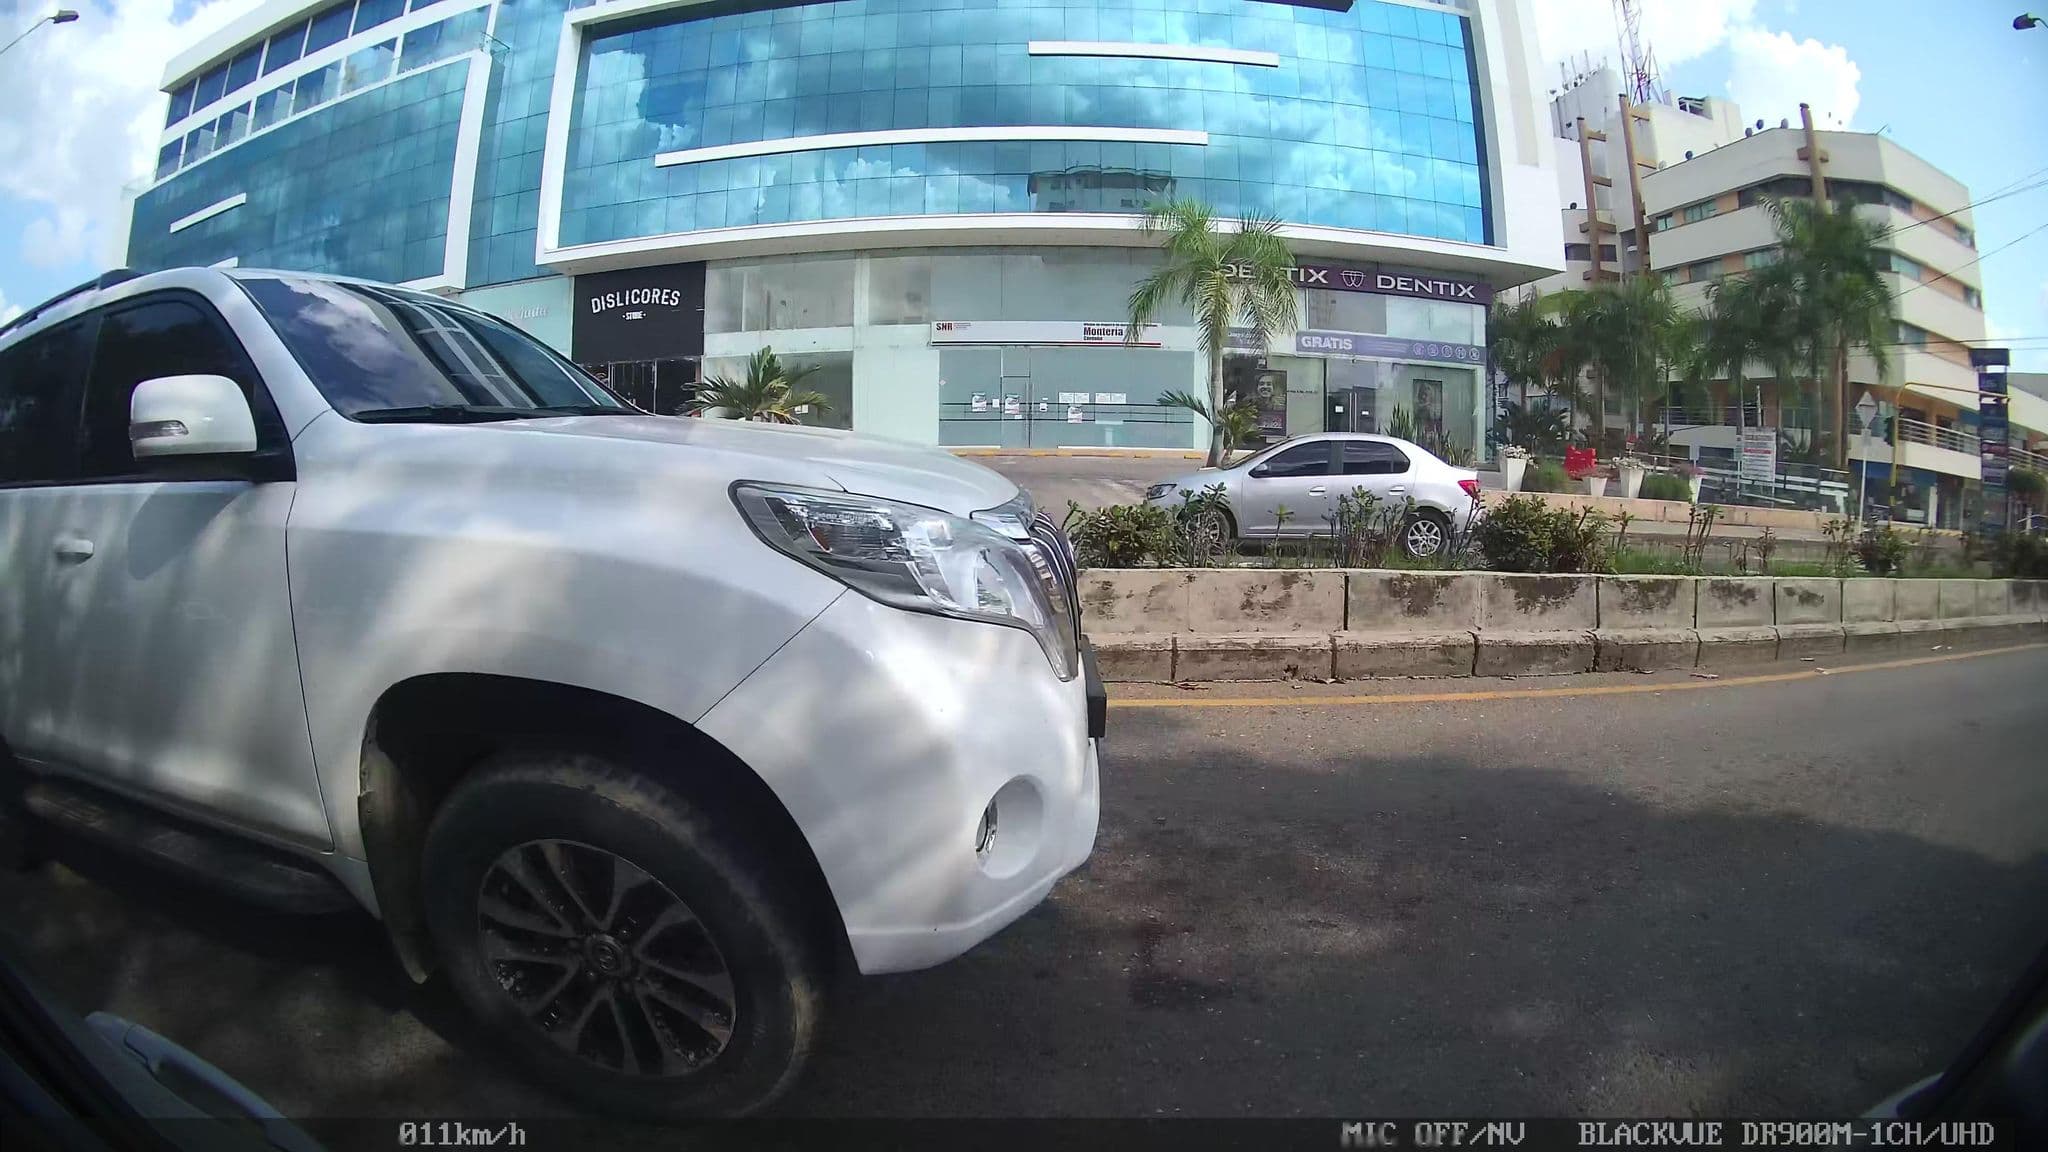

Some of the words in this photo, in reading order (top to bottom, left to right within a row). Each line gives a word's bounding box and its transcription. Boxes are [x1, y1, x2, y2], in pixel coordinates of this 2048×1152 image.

[1220, 264, 1328, 284] DETIX
[1376, 275, 1475, 299] DENTIX
[591, 288, 681, 314] DISLICORES
[936, 322, 953, 331] SNR
[1301, 335, 1353, 350] GRATIS
